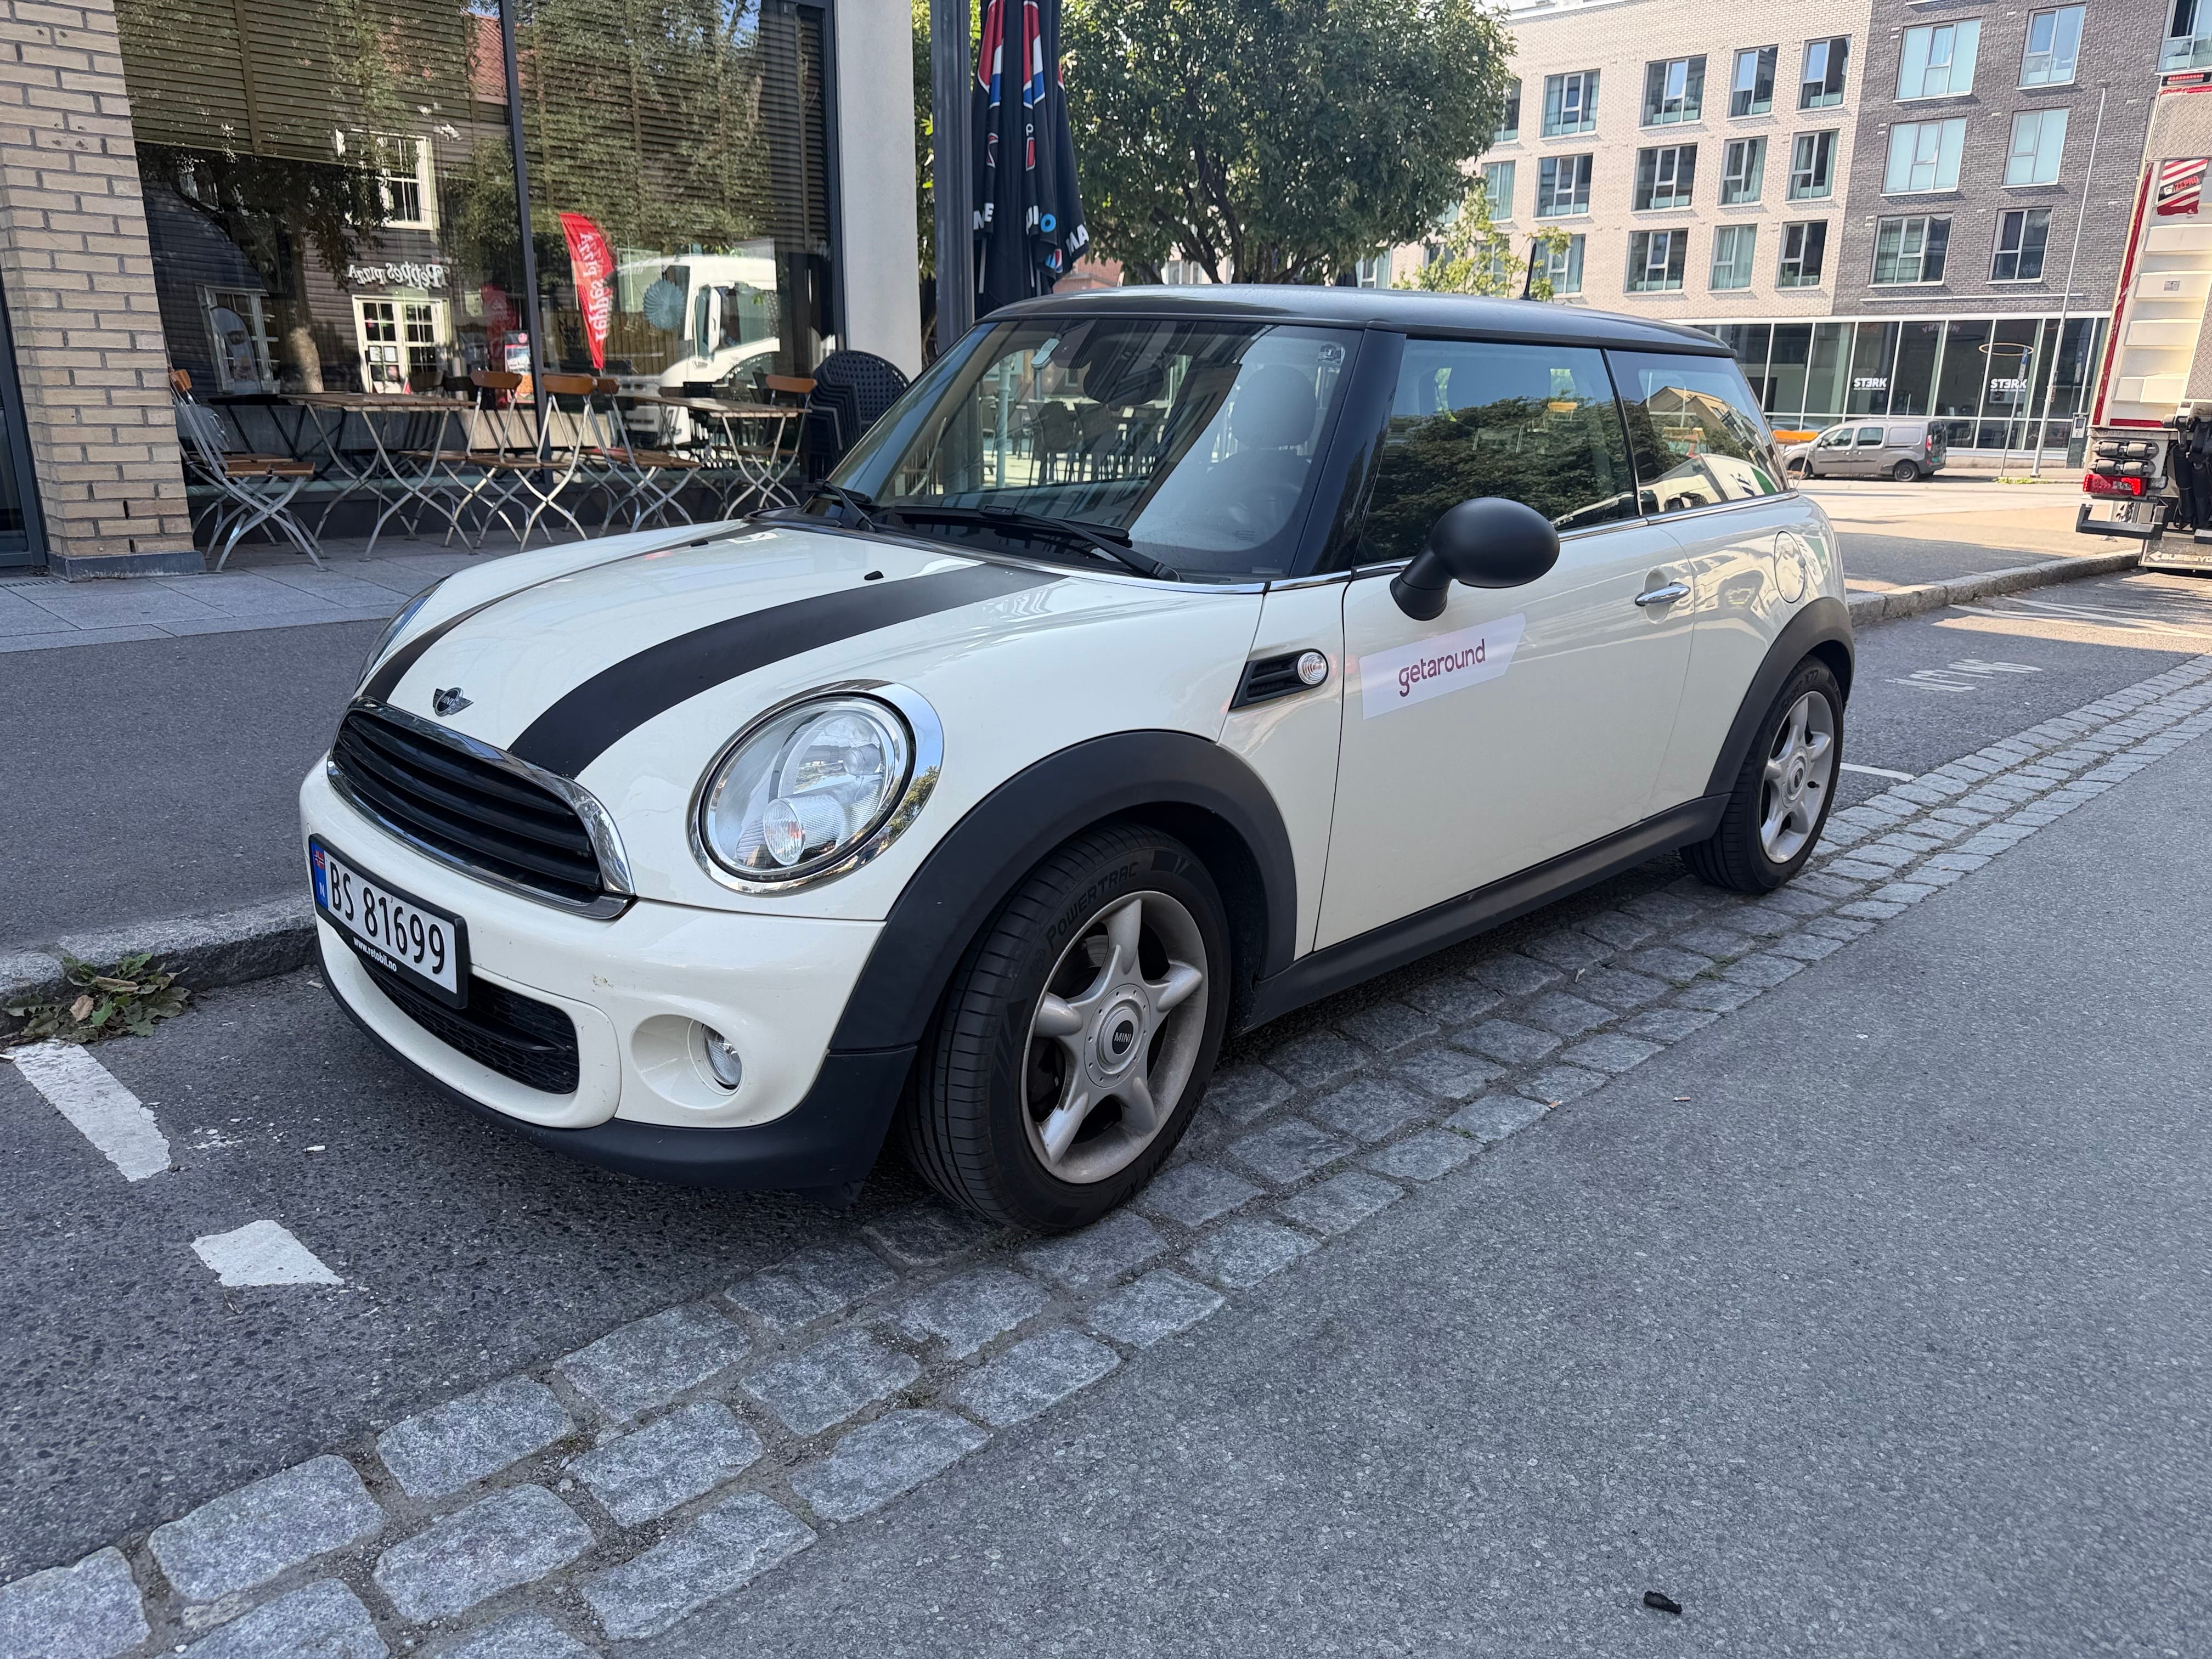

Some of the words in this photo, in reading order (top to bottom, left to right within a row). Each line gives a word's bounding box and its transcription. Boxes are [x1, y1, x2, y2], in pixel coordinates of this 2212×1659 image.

[2174, 175, 2199, 192] ZEPRO
[1398, 638, 1486, 697] getaround
[319, 882, 325, 898] N
[330, 861, 354, 921] BS
[363, 887, 445, 974] 81699
[353, 936, 397, 972] www.retobil.no
[1114, 1031, 1132, 1043] MINI
